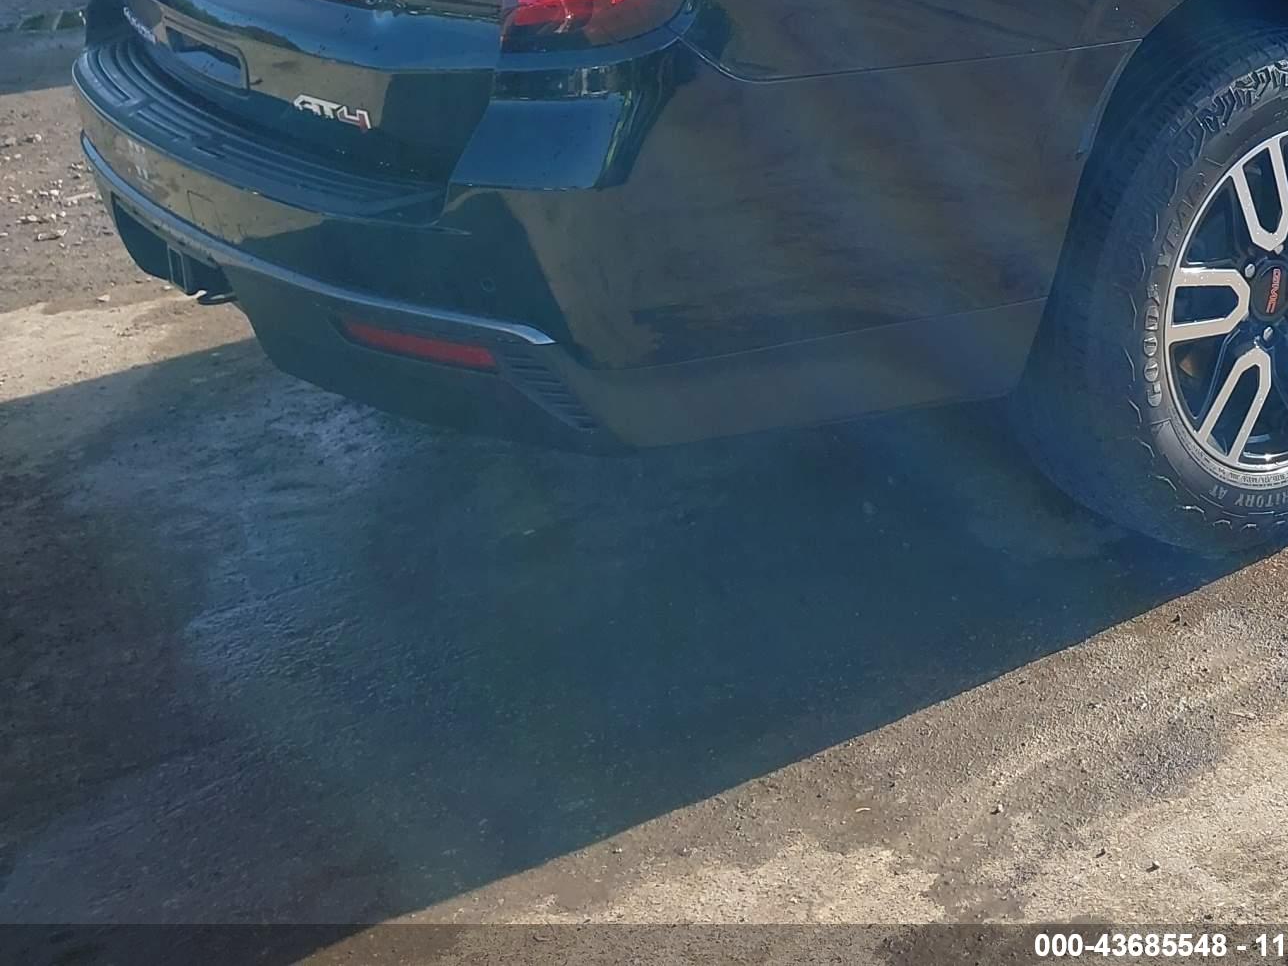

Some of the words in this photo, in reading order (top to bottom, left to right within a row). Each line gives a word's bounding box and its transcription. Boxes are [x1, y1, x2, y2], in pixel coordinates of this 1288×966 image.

[293, 94, 372, 132] AT4
[1266, 268, 1282, 314] GMC
[1208, 483, 1229, 500] AT
